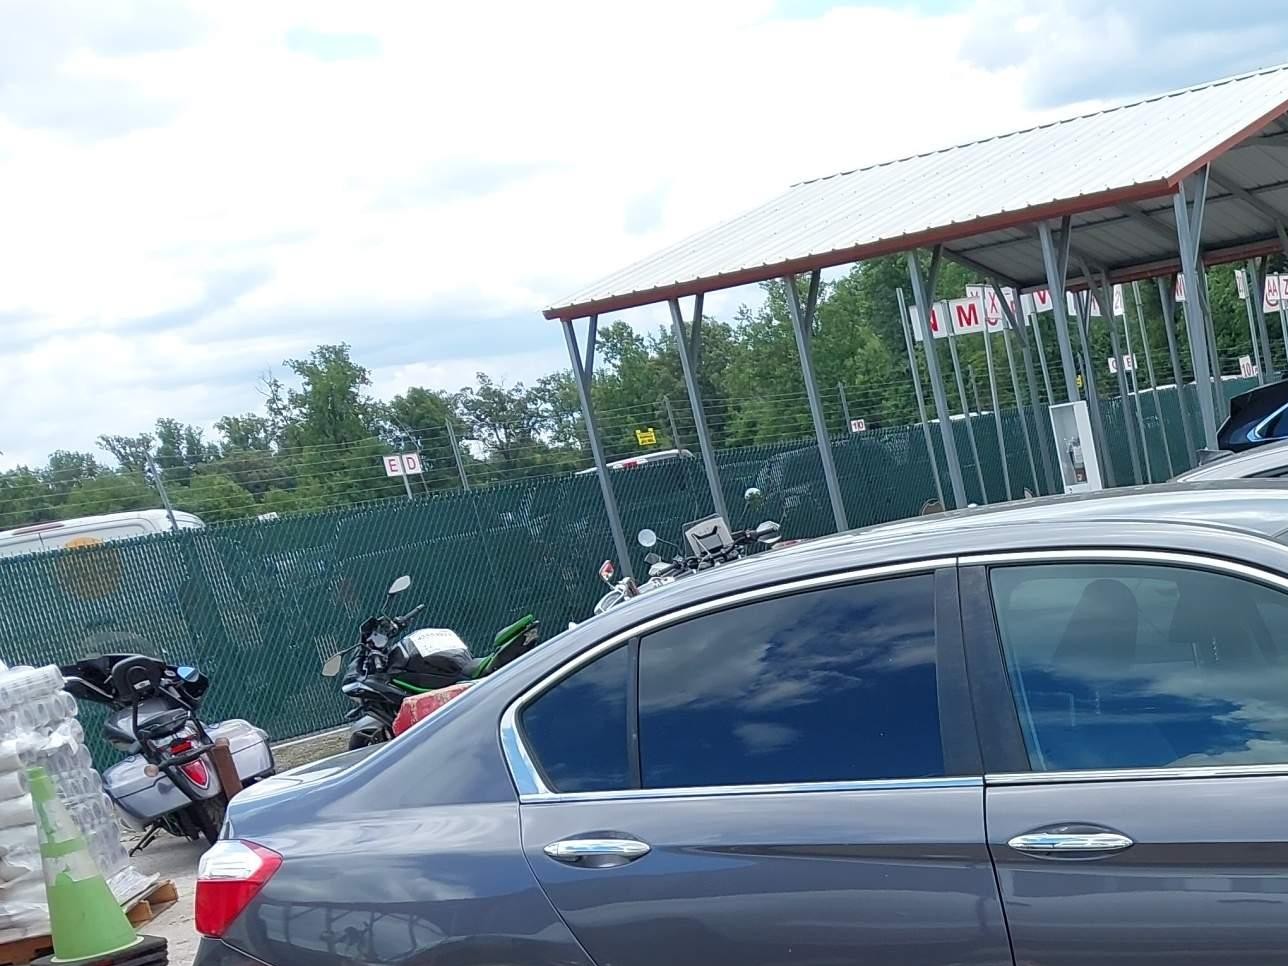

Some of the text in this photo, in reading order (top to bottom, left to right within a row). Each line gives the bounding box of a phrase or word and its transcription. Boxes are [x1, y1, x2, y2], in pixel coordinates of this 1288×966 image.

[1267, 279, 1278, 297] AA
[988, 291, 998, 314] X
[956, 303, 979, 328] M
[388, 459, 398, 472] E
[406, 457, 416, 470] D
